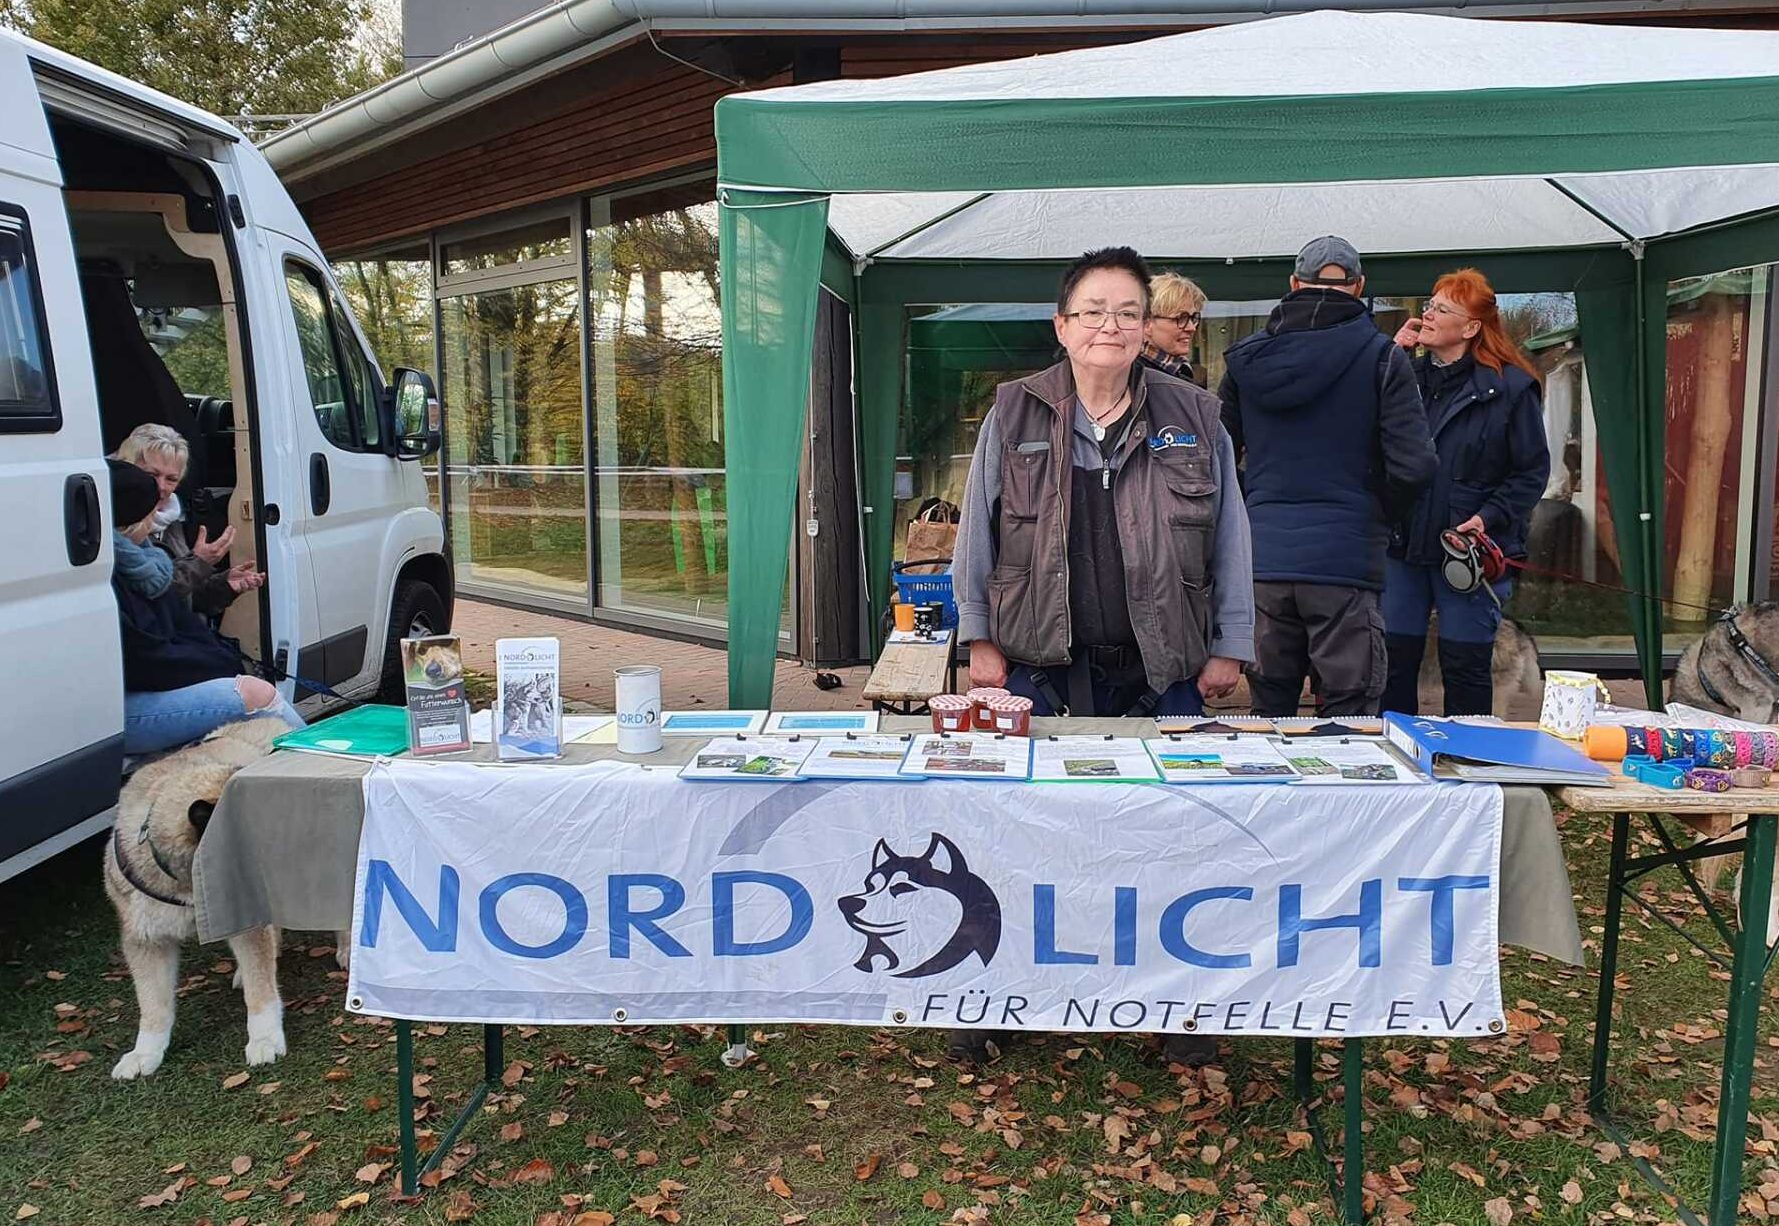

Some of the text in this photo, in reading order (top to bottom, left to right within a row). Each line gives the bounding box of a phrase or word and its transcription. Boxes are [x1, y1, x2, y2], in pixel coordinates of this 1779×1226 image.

[503, 653, 527, 661] NORD
[359, 858, 1491, 969] NORD LICHT
[921, 988, 1484, 1032] FÜR NOTFELLE E.V.
